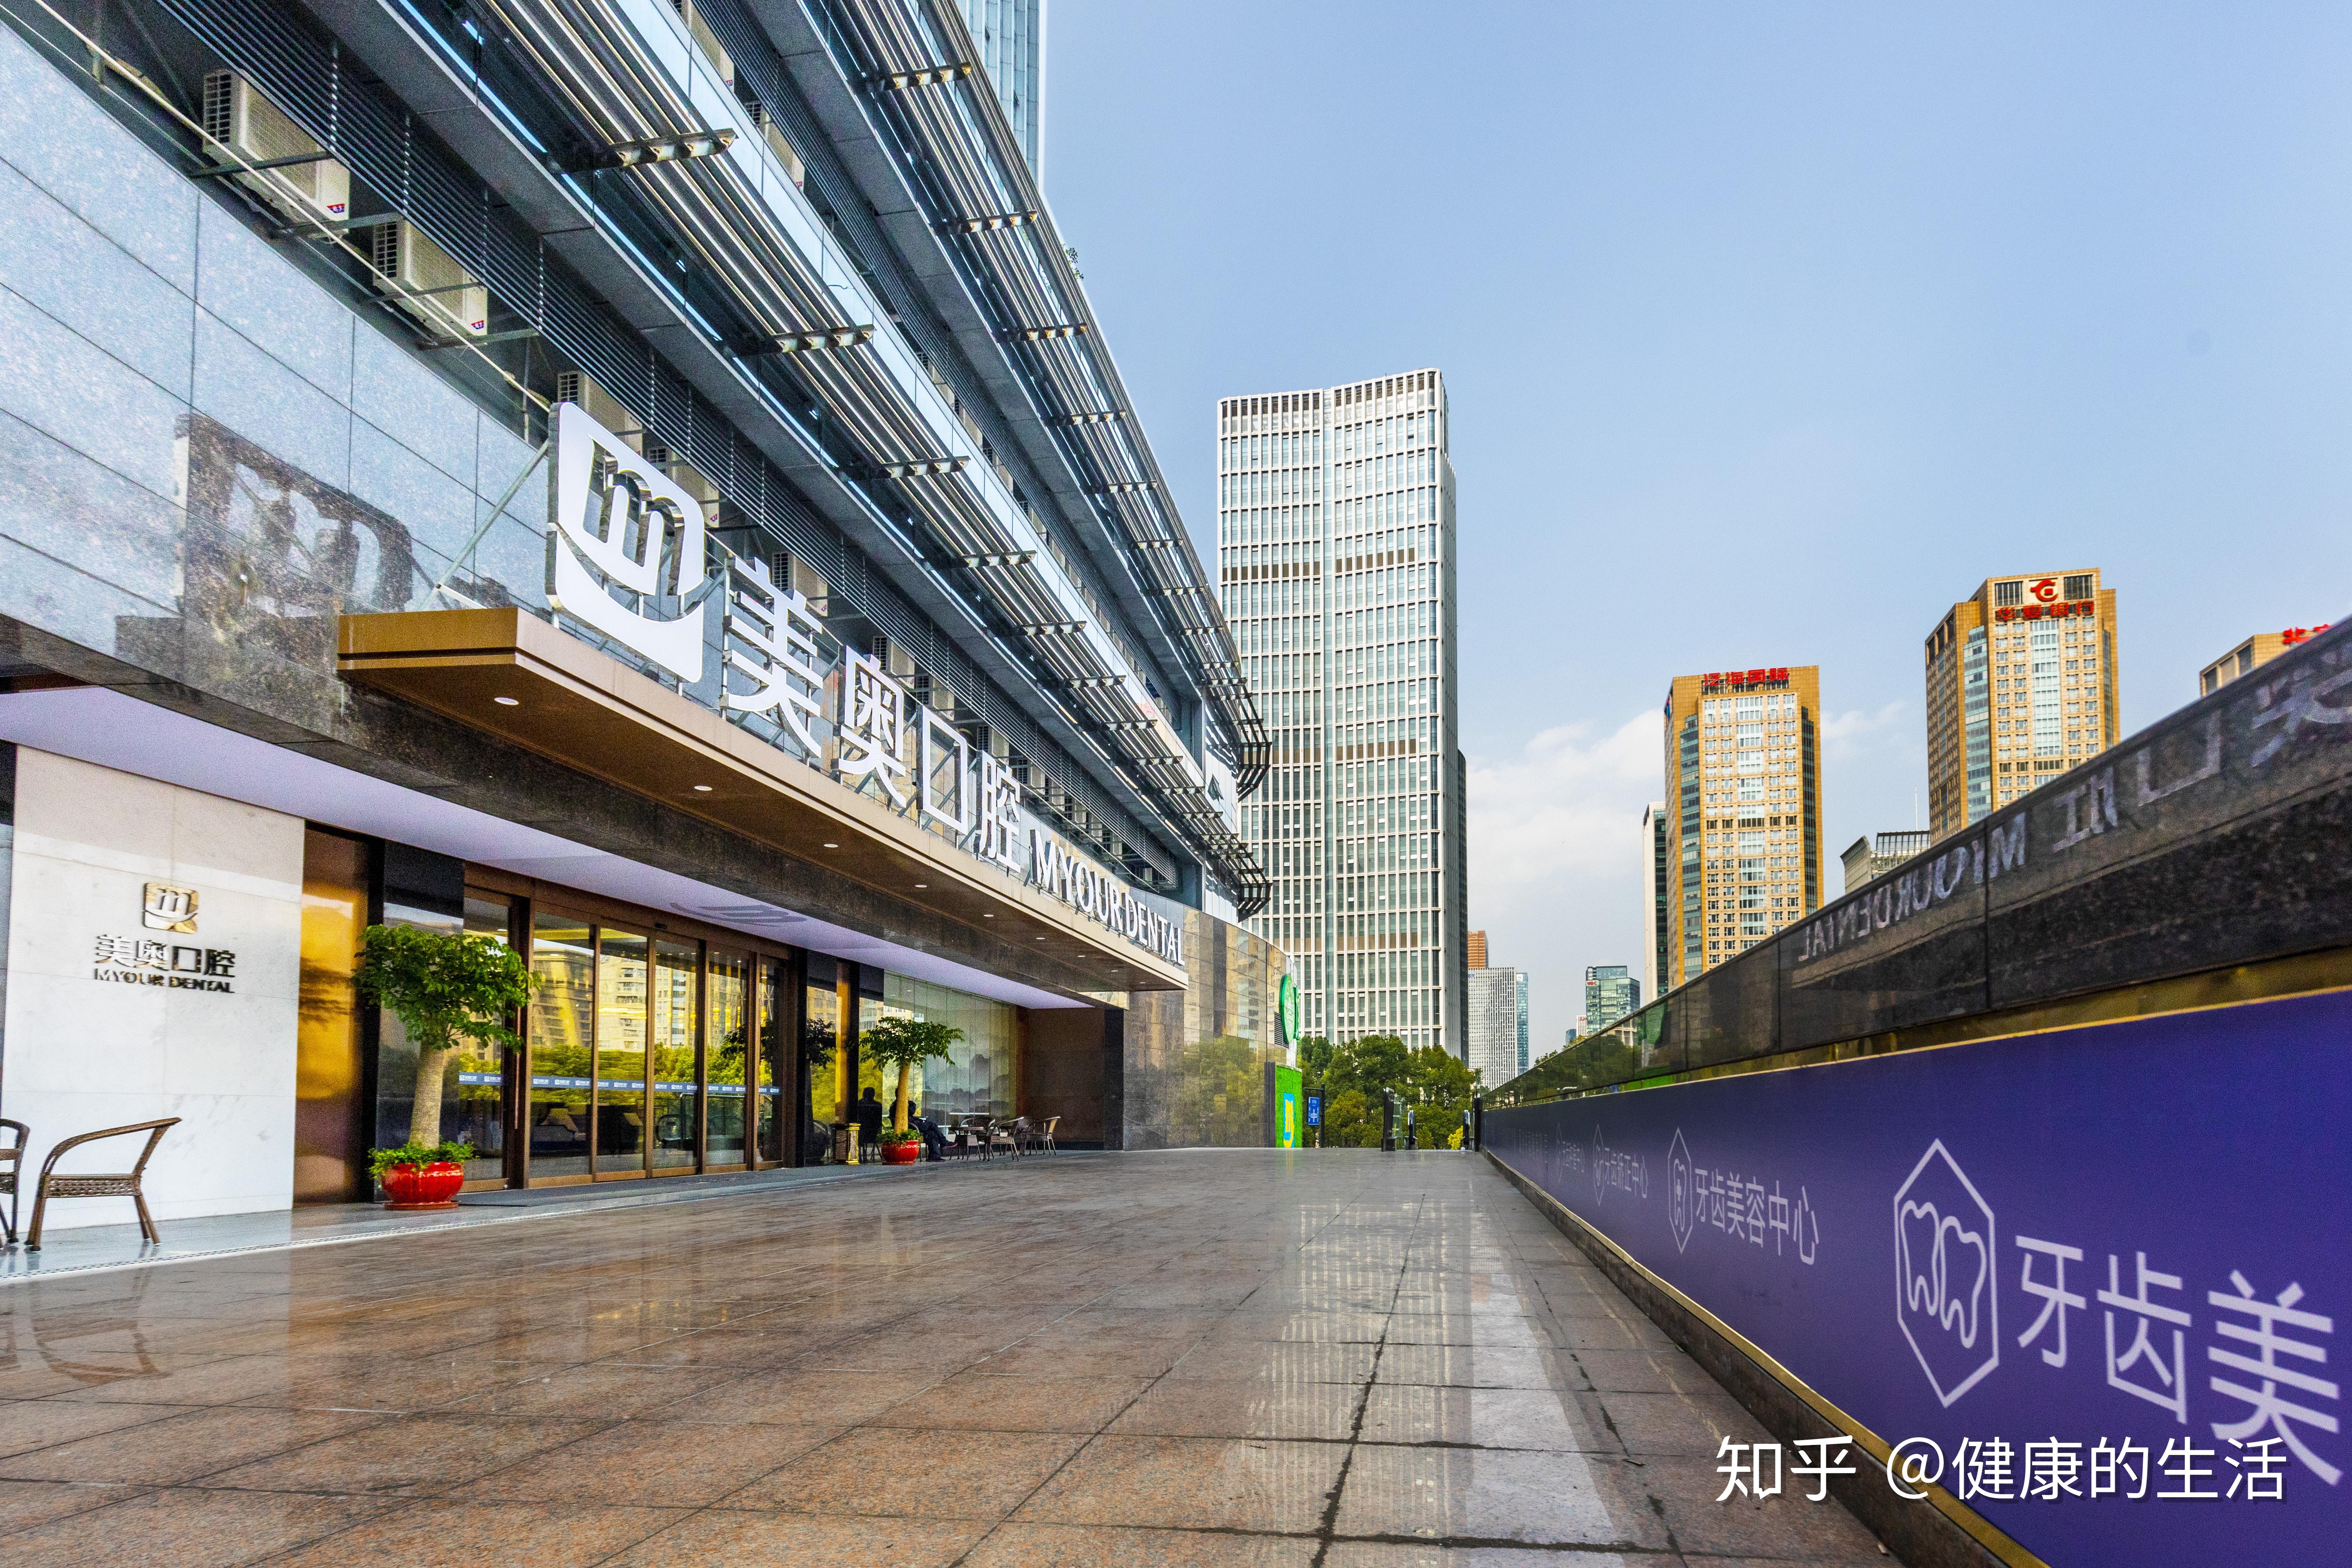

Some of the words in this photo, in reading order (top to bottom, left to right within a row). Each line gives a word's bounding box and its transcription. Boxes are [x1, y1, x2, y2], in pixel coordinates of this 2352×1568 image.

[1995, 601, 2095, 621] 华夏银行
[1703, 667, 1789, 686] 泛海国际
[728, 556, 1021, 873] 美奥口腔
[1031, 829, 1124, 931] MYOUR
[1122, 892, 1185, 966] DENTAL
[94, 934, 236, 977] 美奥口腔
[94, 968, 165, 987] MYOUR
[169, 976, 235, 993] DENTAL
[1695, 1168, 1819, 1265] 牙齿美容中心
[2015, 1235, 2343, 1487] 牙齿美
